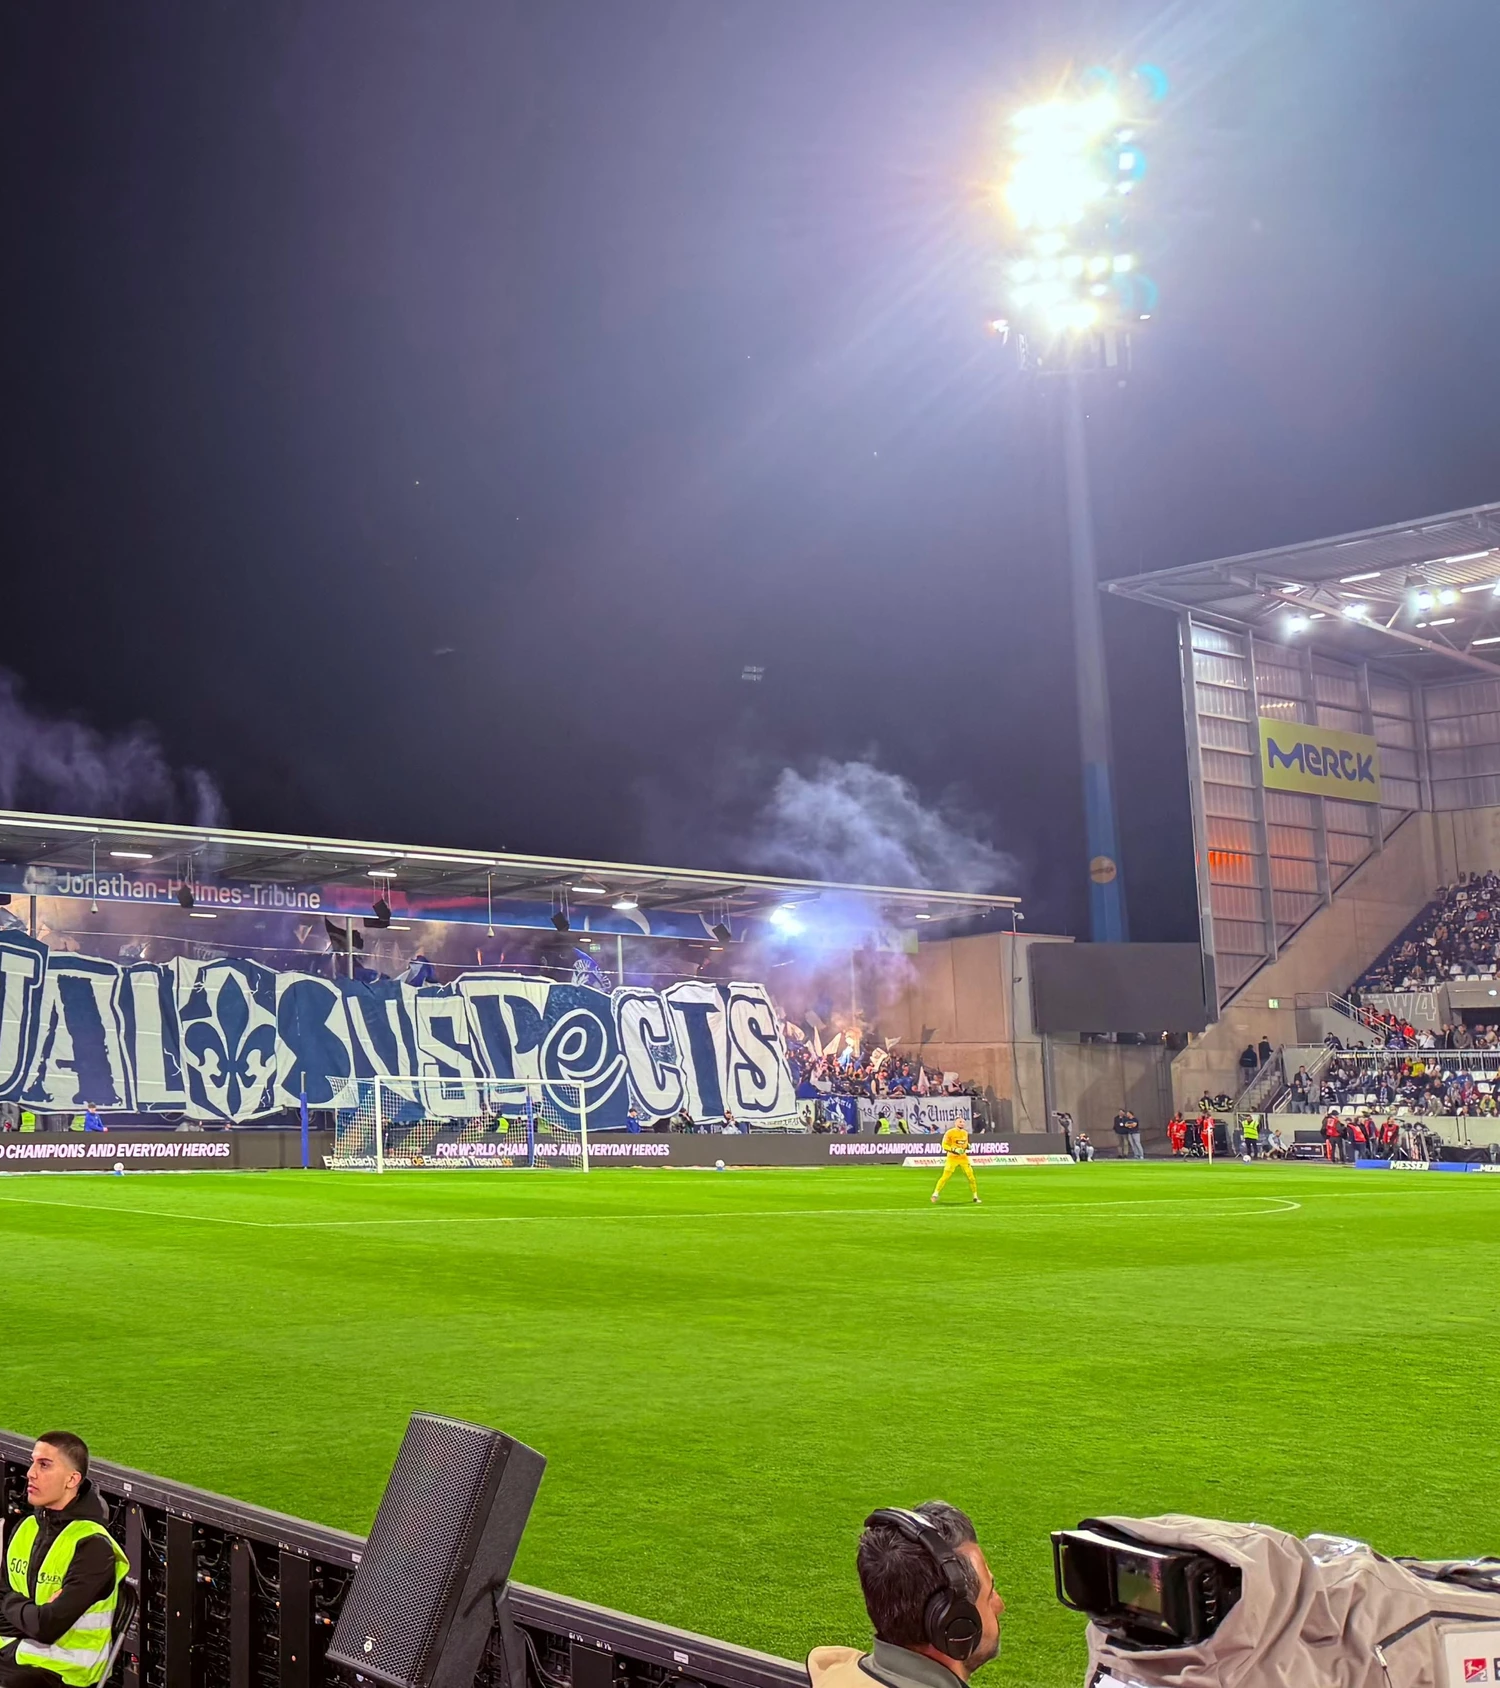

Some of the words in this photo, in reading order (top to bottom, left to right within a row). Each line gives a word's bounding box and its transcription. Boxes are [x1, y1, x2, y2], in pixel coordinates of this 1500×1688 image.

[58, 872, 321, 909] Jonathan-Himes-Tribüne
[6, 1144, 86, 1159] CHAMPIONS
[86, 1143, 117, 1158] AND
[117, 1143, 183, 1158] EVERYDAY
[182, 1143, 230, 1157] HEROES
[436, 1143, 458, 1156] FOR
[459, 1143, 496, 1156] WORLD
[497, 1143, 558, 1156] CHAMIONS
[558, 1143, 581, 1156] AND
[583, 1143, 632, 1156] VERYDAY
[632, 1143, 670, 1156] HEROES
[829, 1143, 847, 1155] FOR
[847, 1143, 877, 1155] WORLD
[877, 1143, 924, 1155] CHAMPIONS
[924, 1142, 941, 1154] AND
[981, 1142, 1010, 1154] HEROES
[322, 1155, 374, 1167] Eisenbach
[424, 1156, 471, 1167] Eisenbach
[10, 1558, 28, 1575] 503
